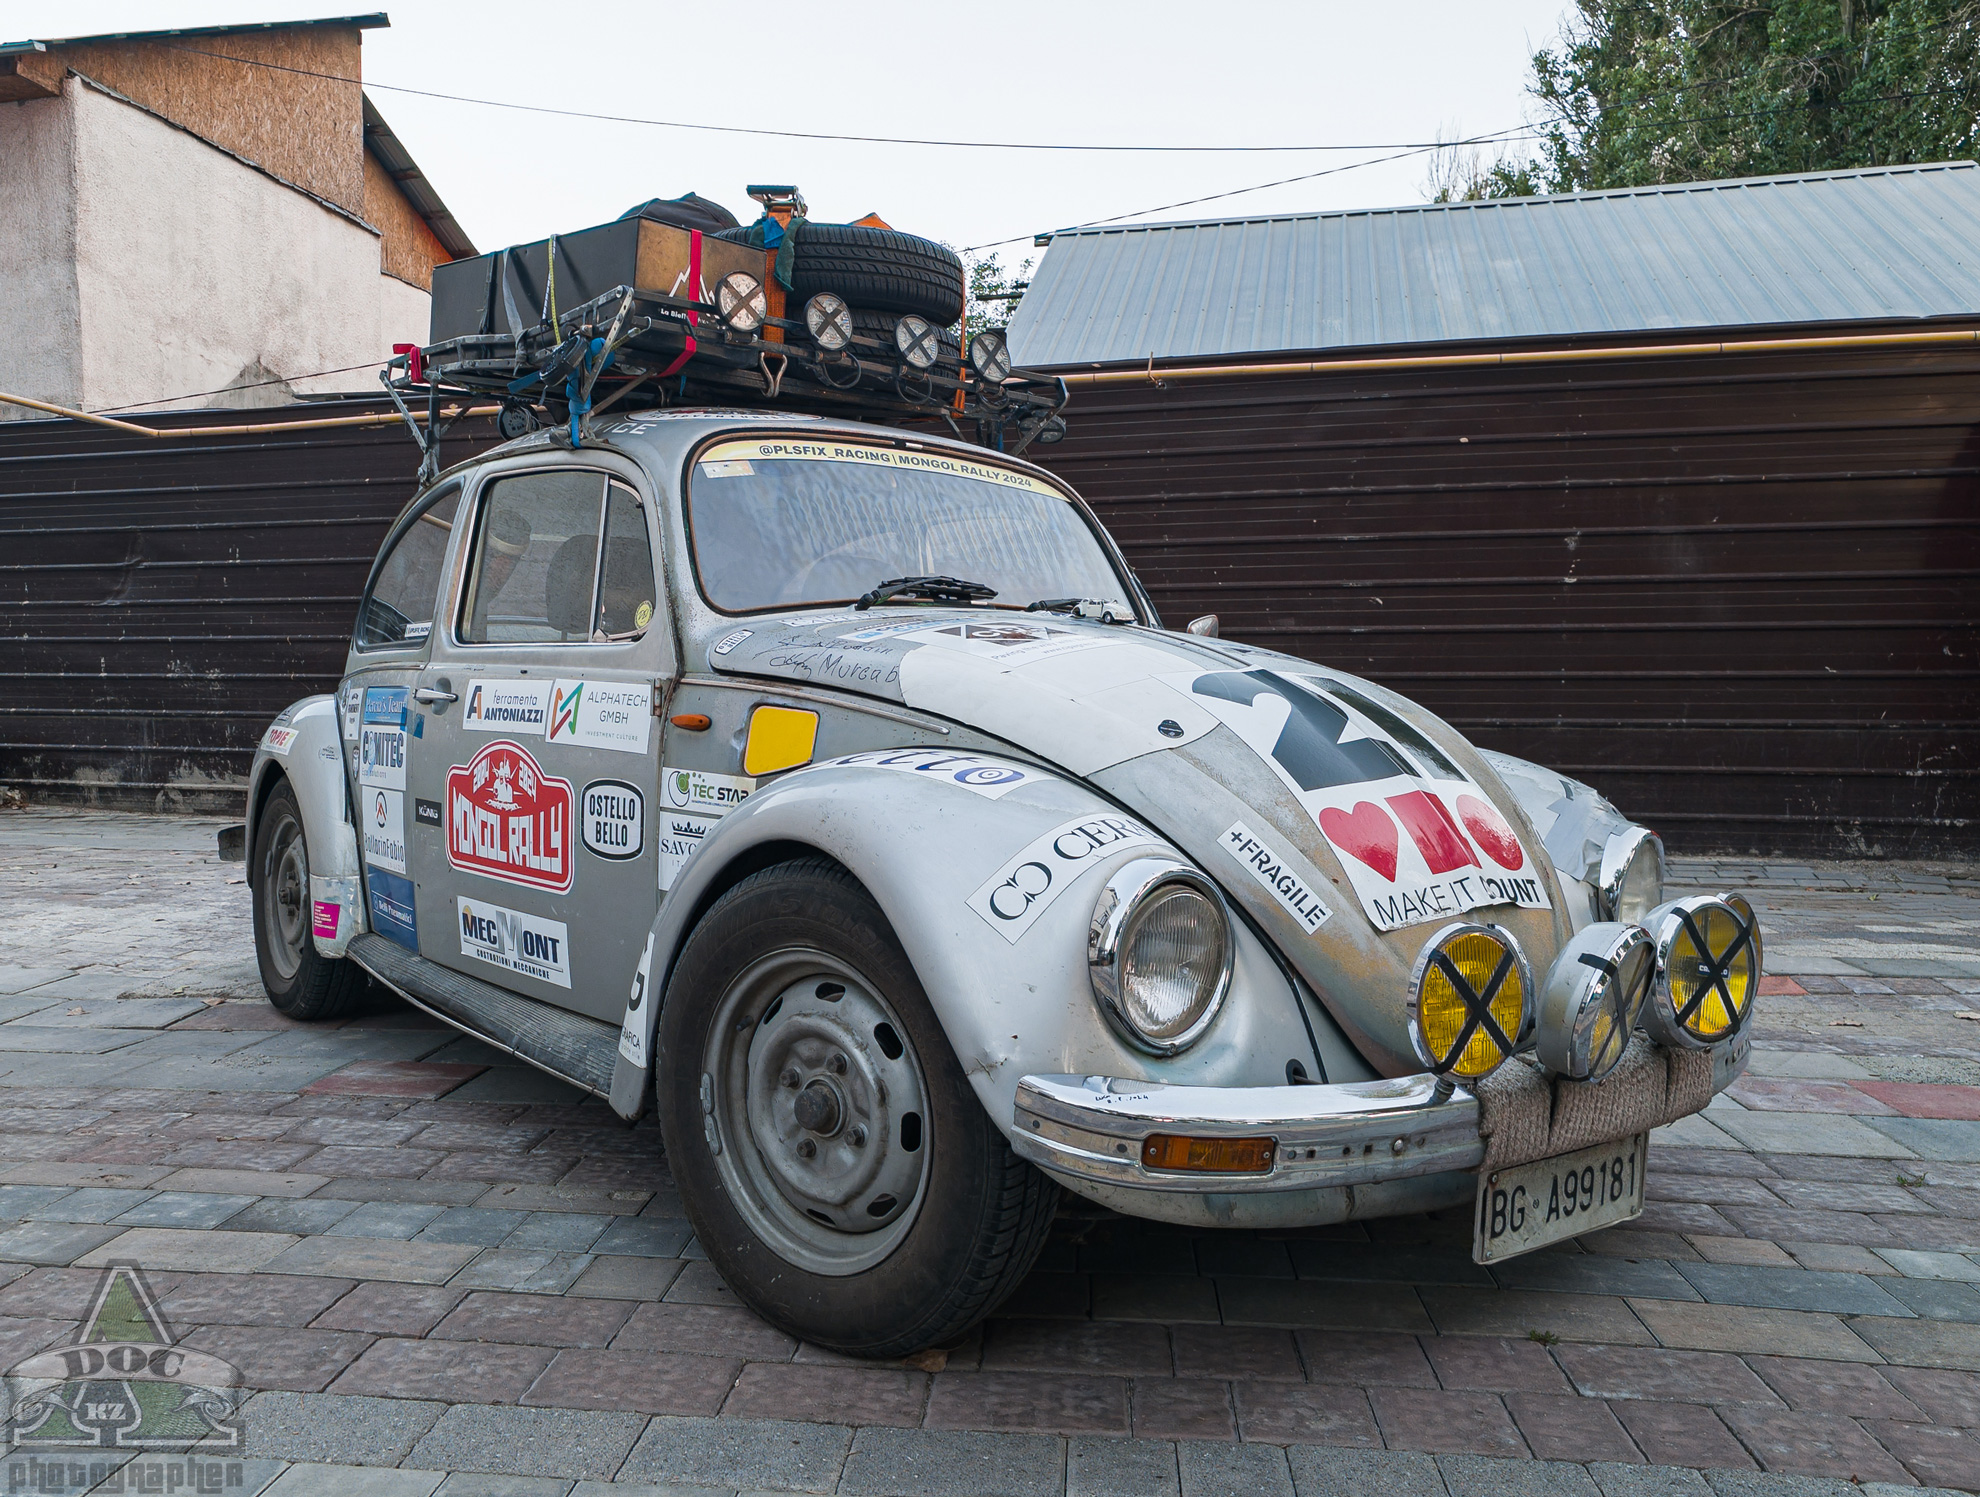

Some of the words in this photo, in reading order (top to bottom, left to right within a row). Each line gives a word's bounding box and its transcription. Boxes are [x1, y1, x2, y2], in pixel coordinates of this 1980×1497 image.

[758, 445, 891, 463] @PLSFIX_RACING
[898, 455, 959, 473] MONGOL
[960, 465, 1000, 481] RALLY
[1002, 474, 1032, 488] 2024
[493, 689, 538, 706] ferramenta
[587, 691, 648, 708] ALPHATECH
[484, 707, 544, 723] ANTONIAZZI
[600, 710, 629, 725] GMBH
[692, 784, 715, 799] TEC
[589, 793, 636, 821] OSTELLO
[452, 786, 508, 863] MONGOL
[508, 801, 563, 874] RALLY
[595, 820, 628, 847] BELLO
[1372, 884, 1452, 926] MAKE
[1448, 876, 1475, 908] IT
[462, 910, 560, 964] MECMONT
[476, 948, 512, 968] COSTRUZIONI
[513, 960, 550, 980] MECCANICHE
[1490, 1184, 1527, 1240] BG
[1545, 1151, 1637, 1224] A99181
